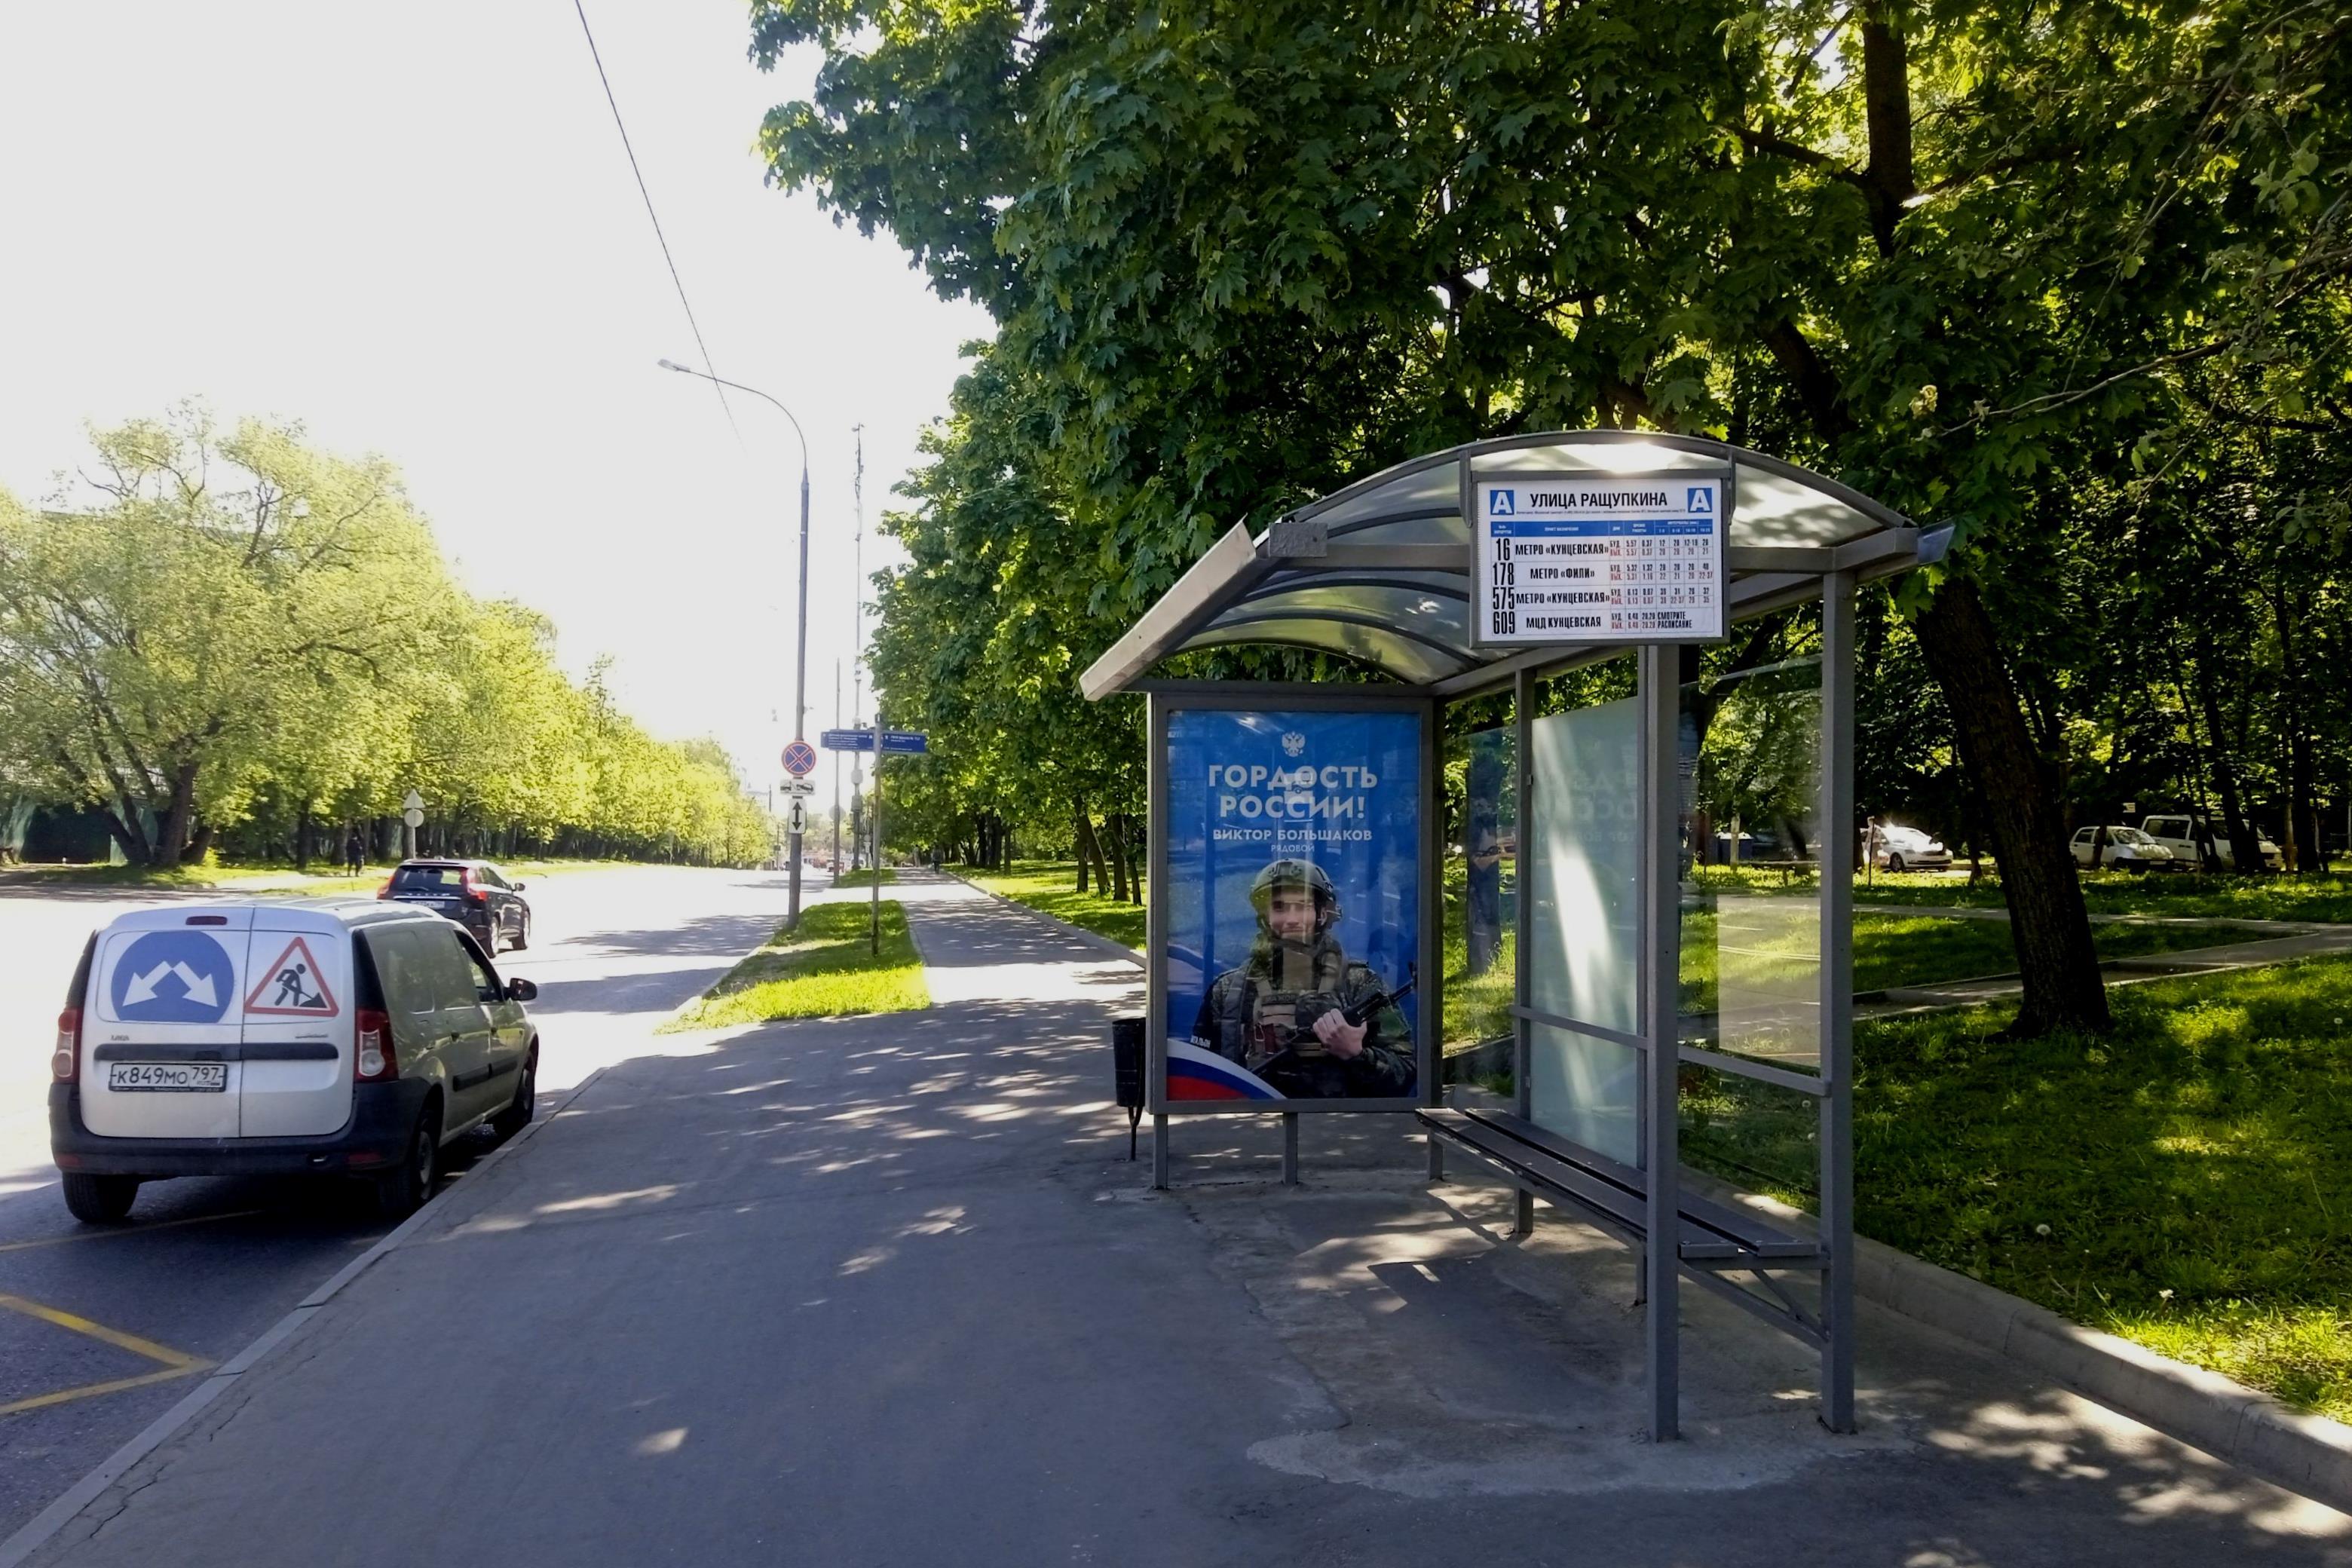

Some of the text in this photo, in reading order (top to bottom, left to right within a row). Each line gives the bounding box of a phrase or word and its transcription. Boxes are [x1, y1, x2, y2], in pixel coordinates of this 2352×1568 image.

[1530, 492, 1668, 509] УЛИЦА РАЩУПКИНА
[1496, 537, 1609, 561] 16 МЕТРО «КУНЦЕВСКАЯ»
[1493, 562, 1594, 585] 178 МЕТРО «ФИЛИ»
[1493, 586, 1609, 610] 575 МЕТРО «КУНЦЕВСКАЯ»
[1493, 611, 1601, 634] 609 МЦД КУНЦЕВСКАЯ
[1658, 611, 1686, 620] СМОТРИТЕ
[1658, 620, 1692, 629] РАСПИСАНИЕ
[1208, 764, 1378, 791] ГОРДОСТЬ
[1220, 795, 1365, 819] РОССИИ!
[1213, 828, 1372, 841] ВИКТОР БОЛЬШАКОВ
[1270, 843, 1315, 853] РЯДОВОЙ
[192, 1067, 220, 1080] 797
